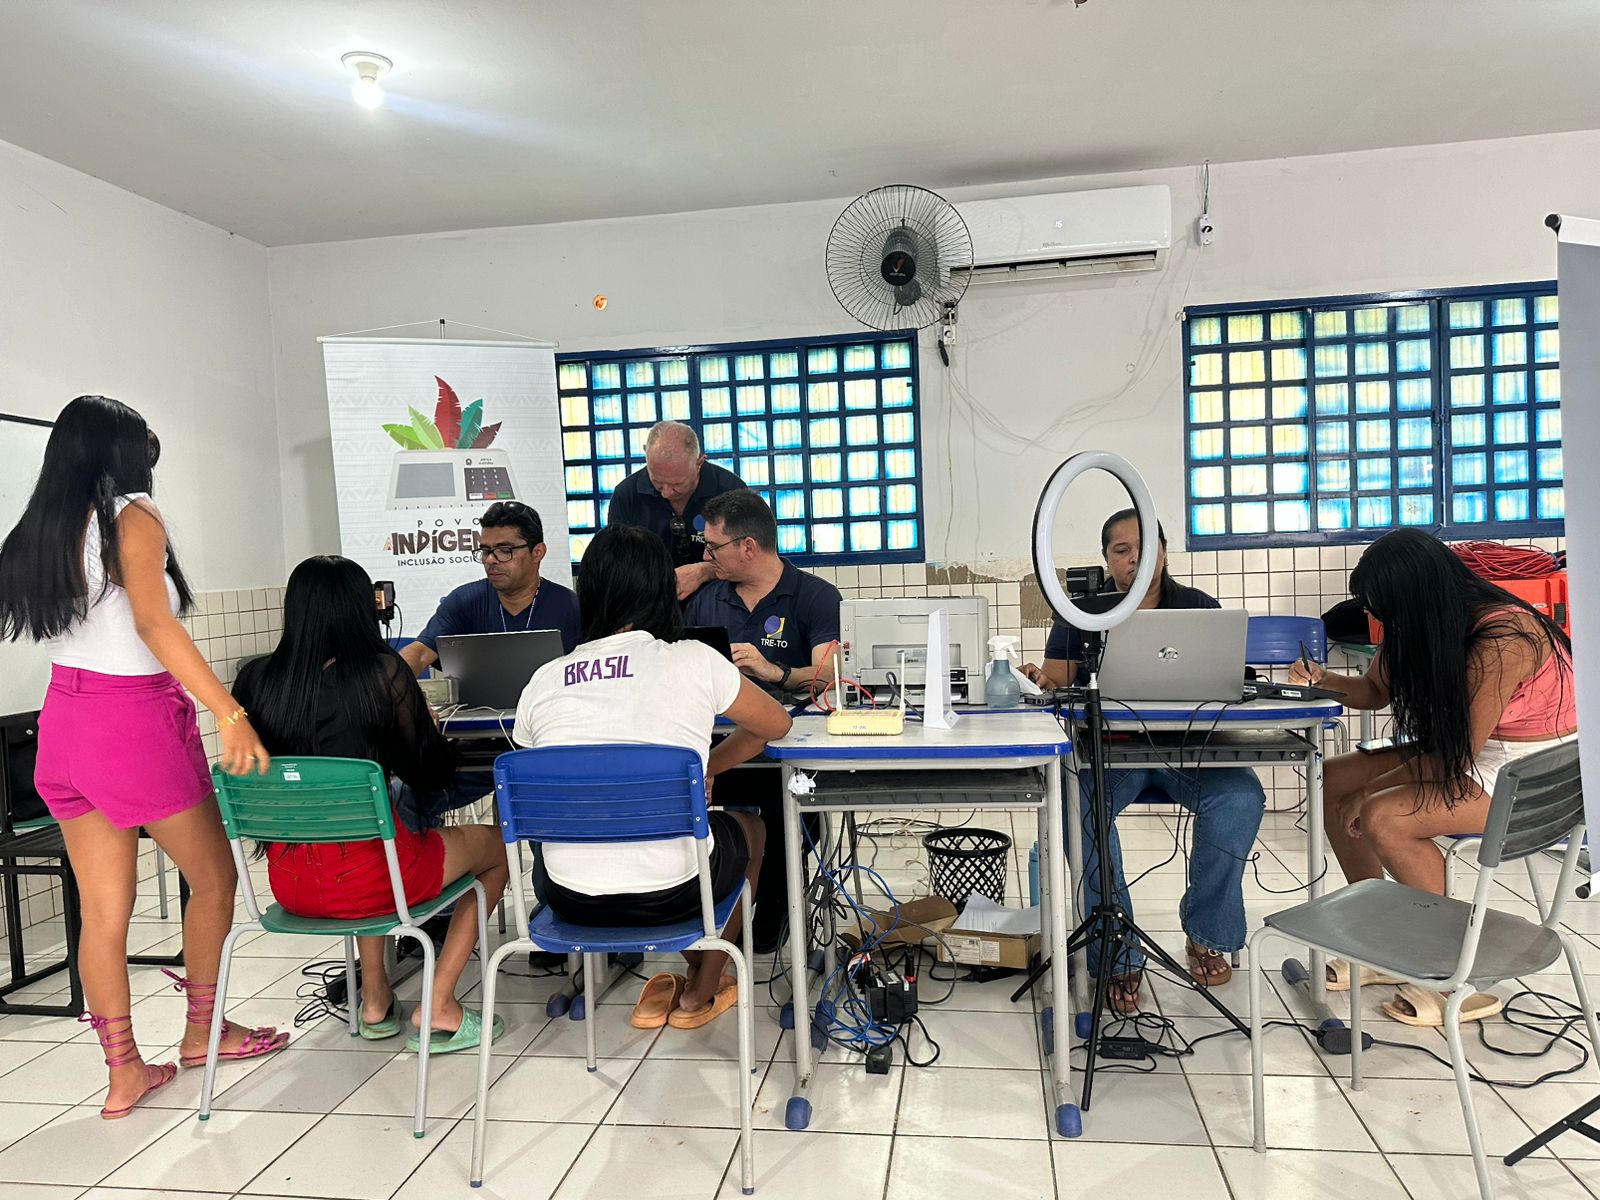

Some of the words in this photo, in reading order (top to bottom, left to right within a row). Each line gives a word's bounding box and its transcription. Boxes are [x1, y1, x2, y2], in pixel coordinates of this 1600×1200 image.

[417, 517, 481, 528] POVO
[391, 528, 482, 556] INDÍGEN
[397, 556, 446, 567] INCLUSÃO
[449, 555, 473, 564] SOCI
[760, 637, 788, 649] TRE-TO
[564, 655, 634, 687] BRASIL
